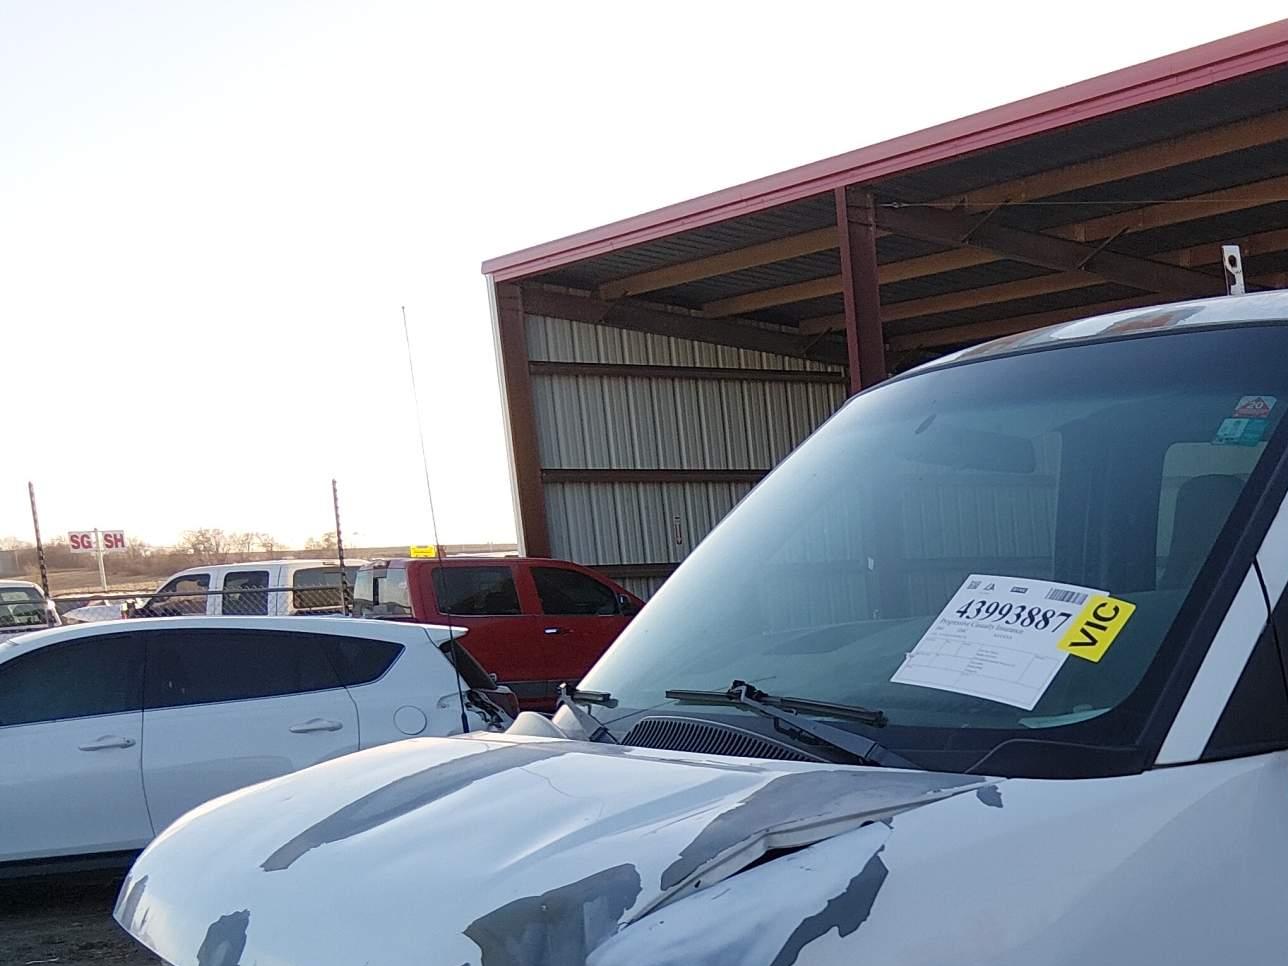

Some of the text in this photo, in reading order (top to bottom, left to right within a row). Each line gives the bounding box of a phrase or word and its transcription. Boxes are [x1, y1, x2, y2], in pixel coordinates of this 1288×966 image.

[70, 533, 125, 549] SG SH
[956, 600, 1073, 633] 43993887
[1068, 602, 1120, 647] VIC
